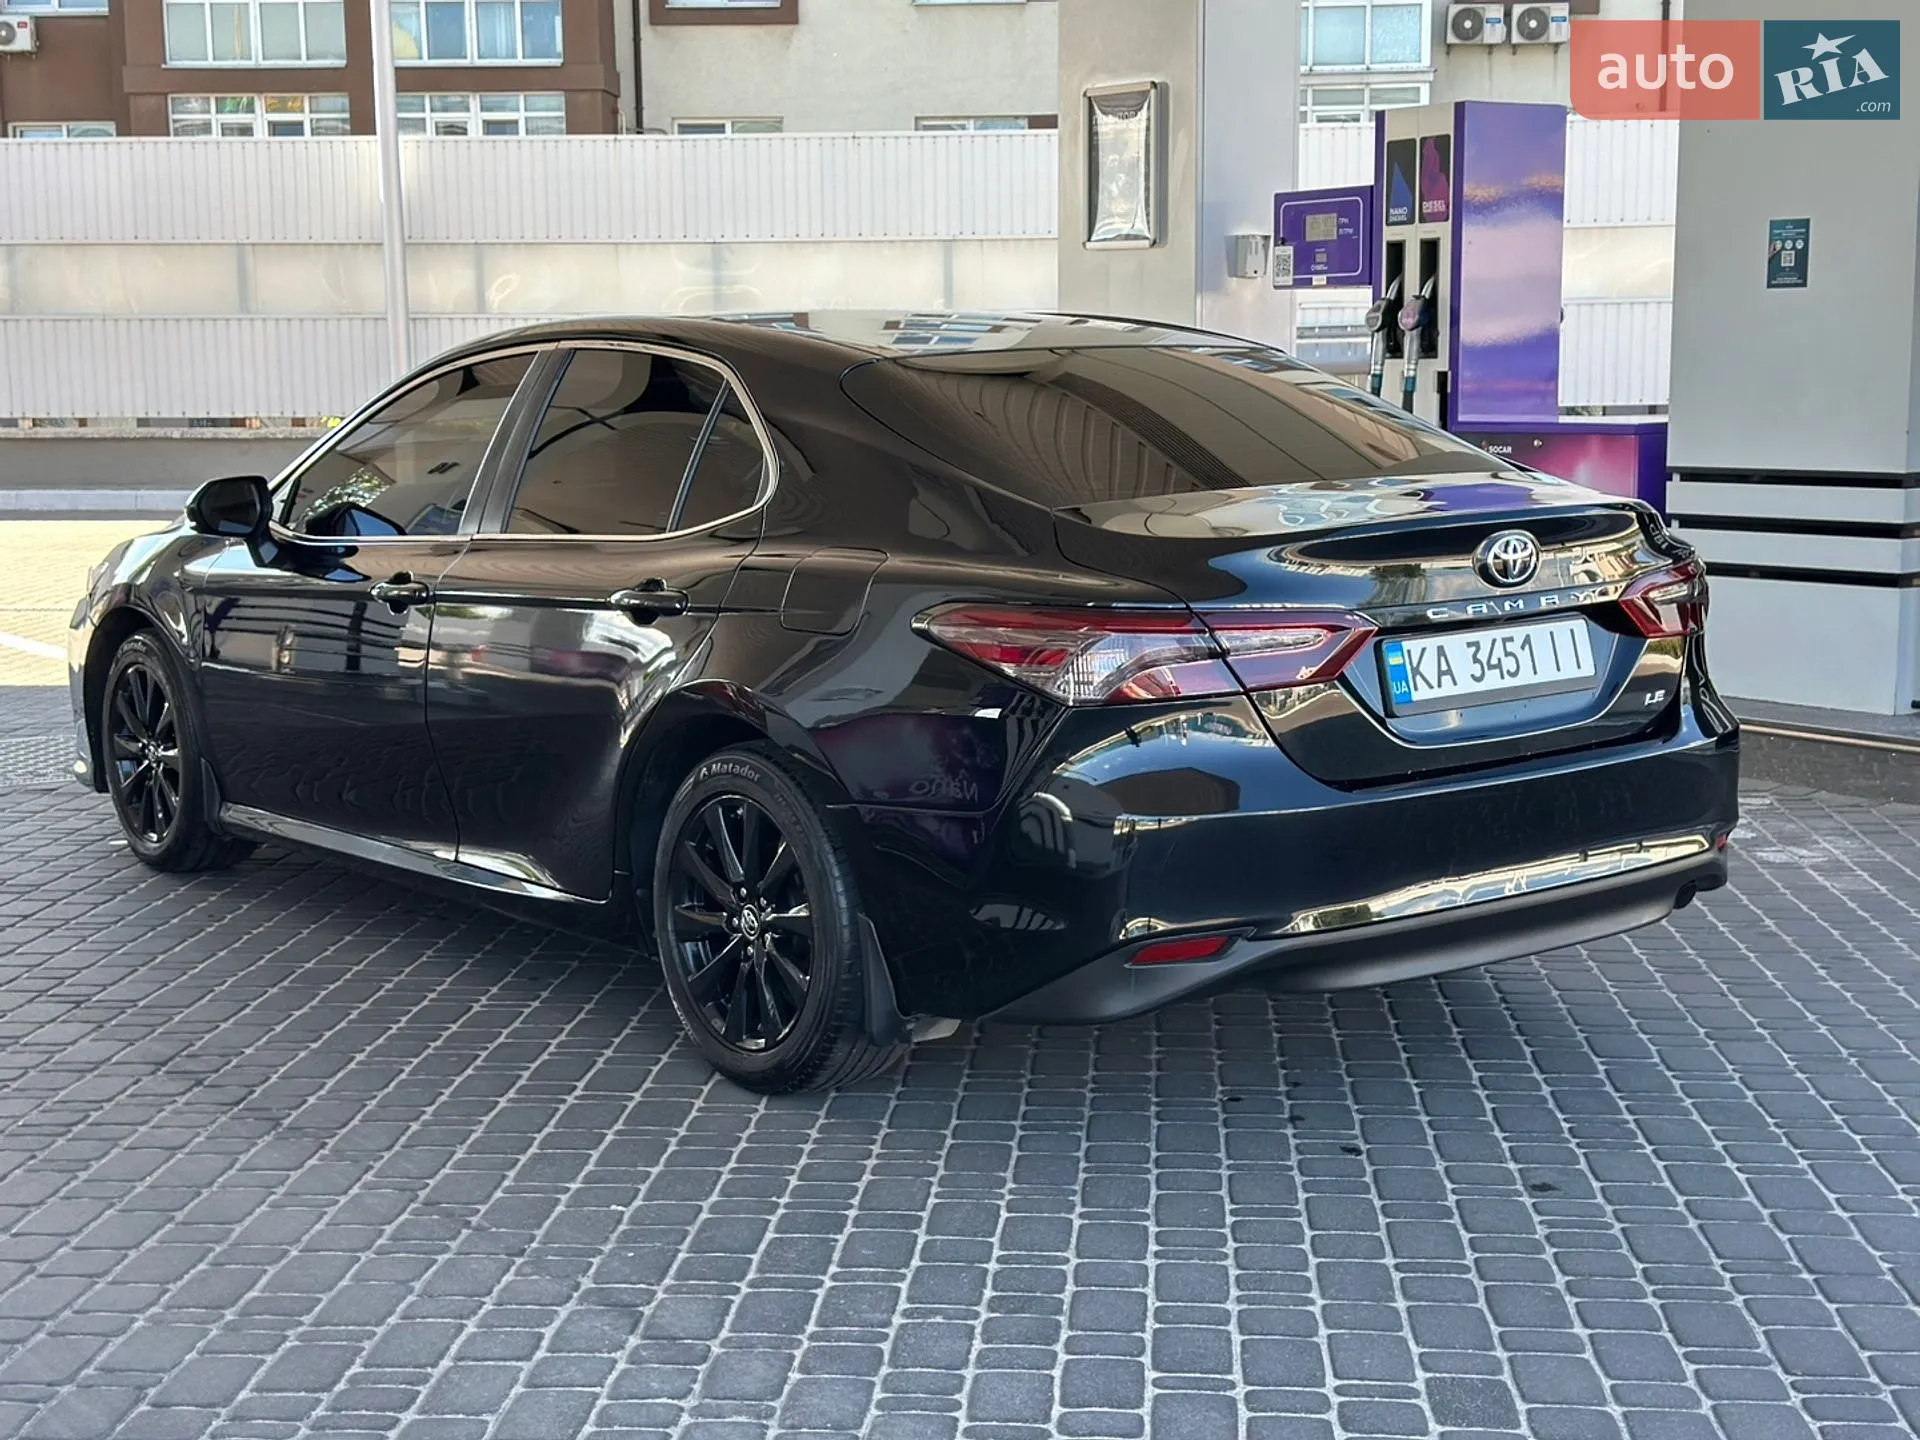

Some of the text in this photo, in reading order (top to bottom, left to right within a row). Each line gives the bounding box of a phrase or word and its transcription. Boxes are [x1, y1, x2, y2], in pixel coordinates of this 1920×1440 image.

[1488, 445, 1513, 454] SOCAR
[1407, 644, 1458, 692] KA
[1466, 633, 1538, 684] 3451
[1393, 682, 1409, 695] UA
[1644, 689, 1666, 707] LE
[710, 762, 761, 782] Matador
